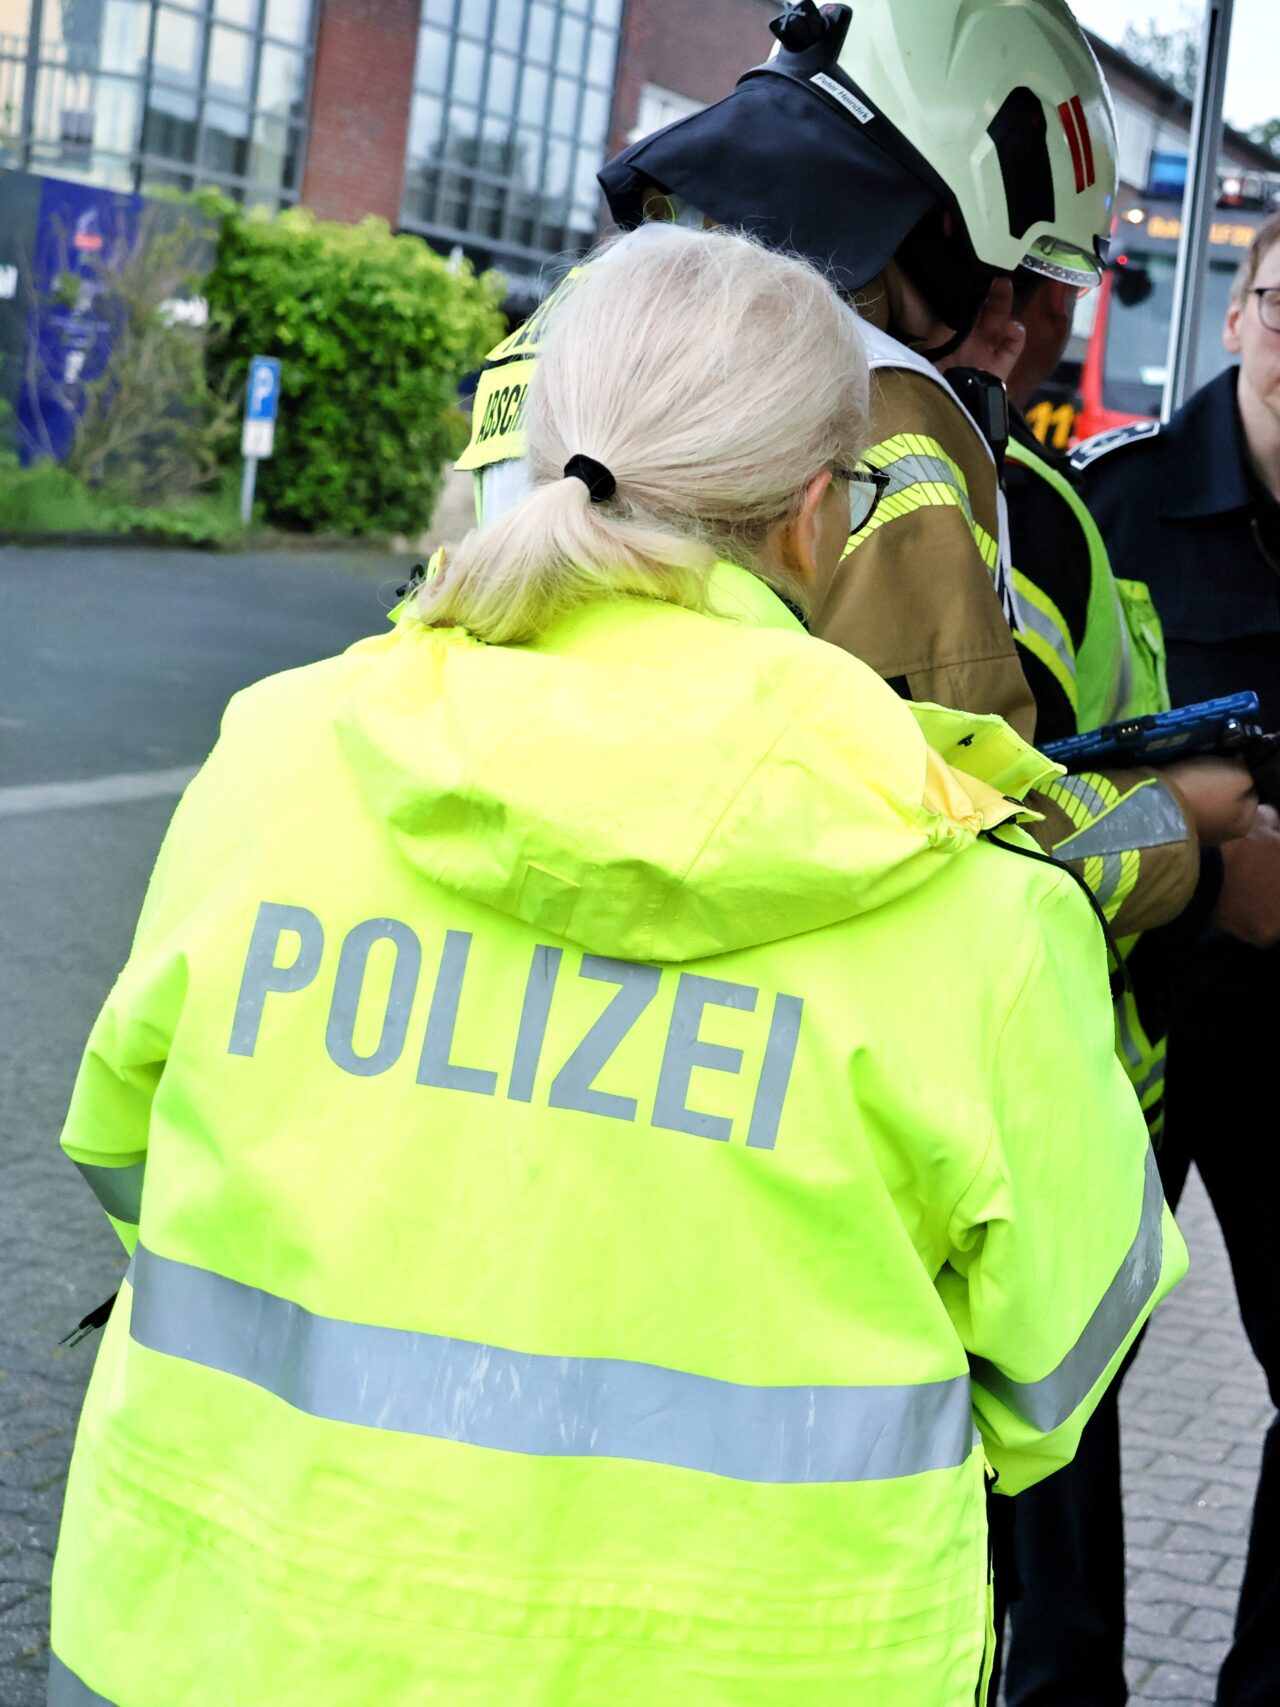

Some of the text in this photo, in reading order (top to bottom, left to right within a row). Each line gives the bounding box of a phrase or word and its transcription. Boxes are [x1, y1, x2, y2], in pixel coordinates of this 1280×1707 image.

[252, 366, 275, 412] P
[1026, 401, 1074, 449] 11
[227, 901, 804, 1151] POLIZEI
